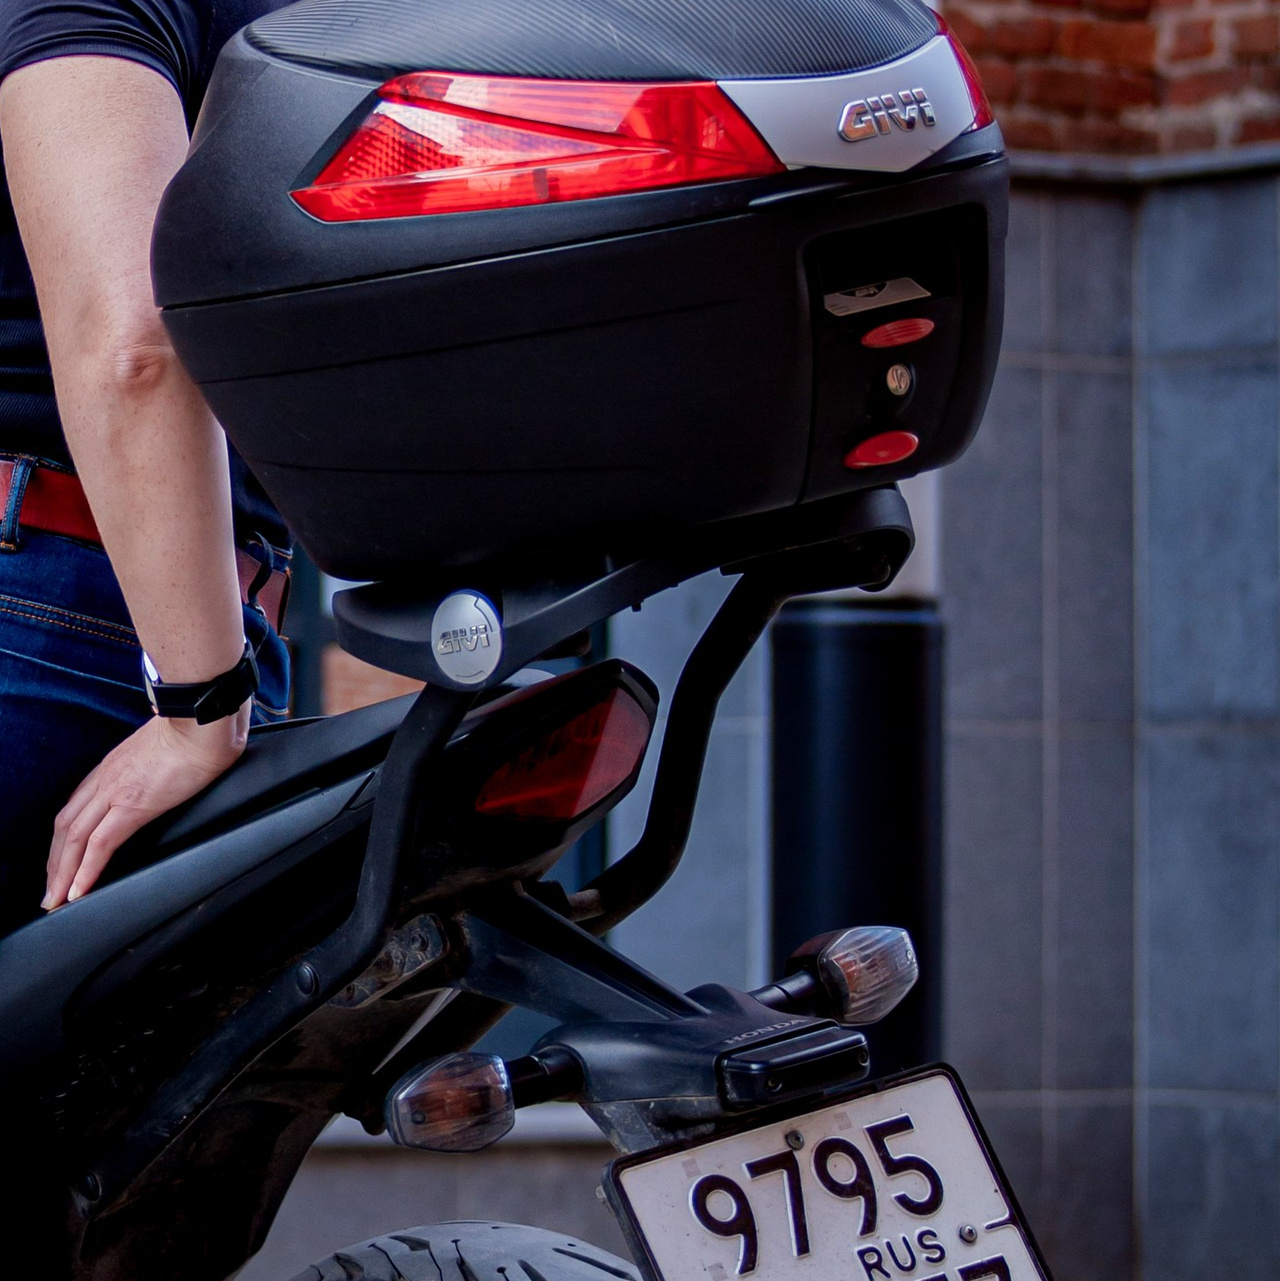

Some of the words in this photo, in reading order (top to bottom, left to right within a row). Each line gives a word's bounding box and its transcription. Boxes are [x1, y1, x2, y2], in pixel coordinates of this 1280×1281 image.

[837, 87, 936, 142] GIVI
[854, 286, 879, 298] GIVI
[436, 624, 490, 655] GIVI
[723, 1019, 806, 1045] HONDA
[690, 1113, 945, 1275] 9795
